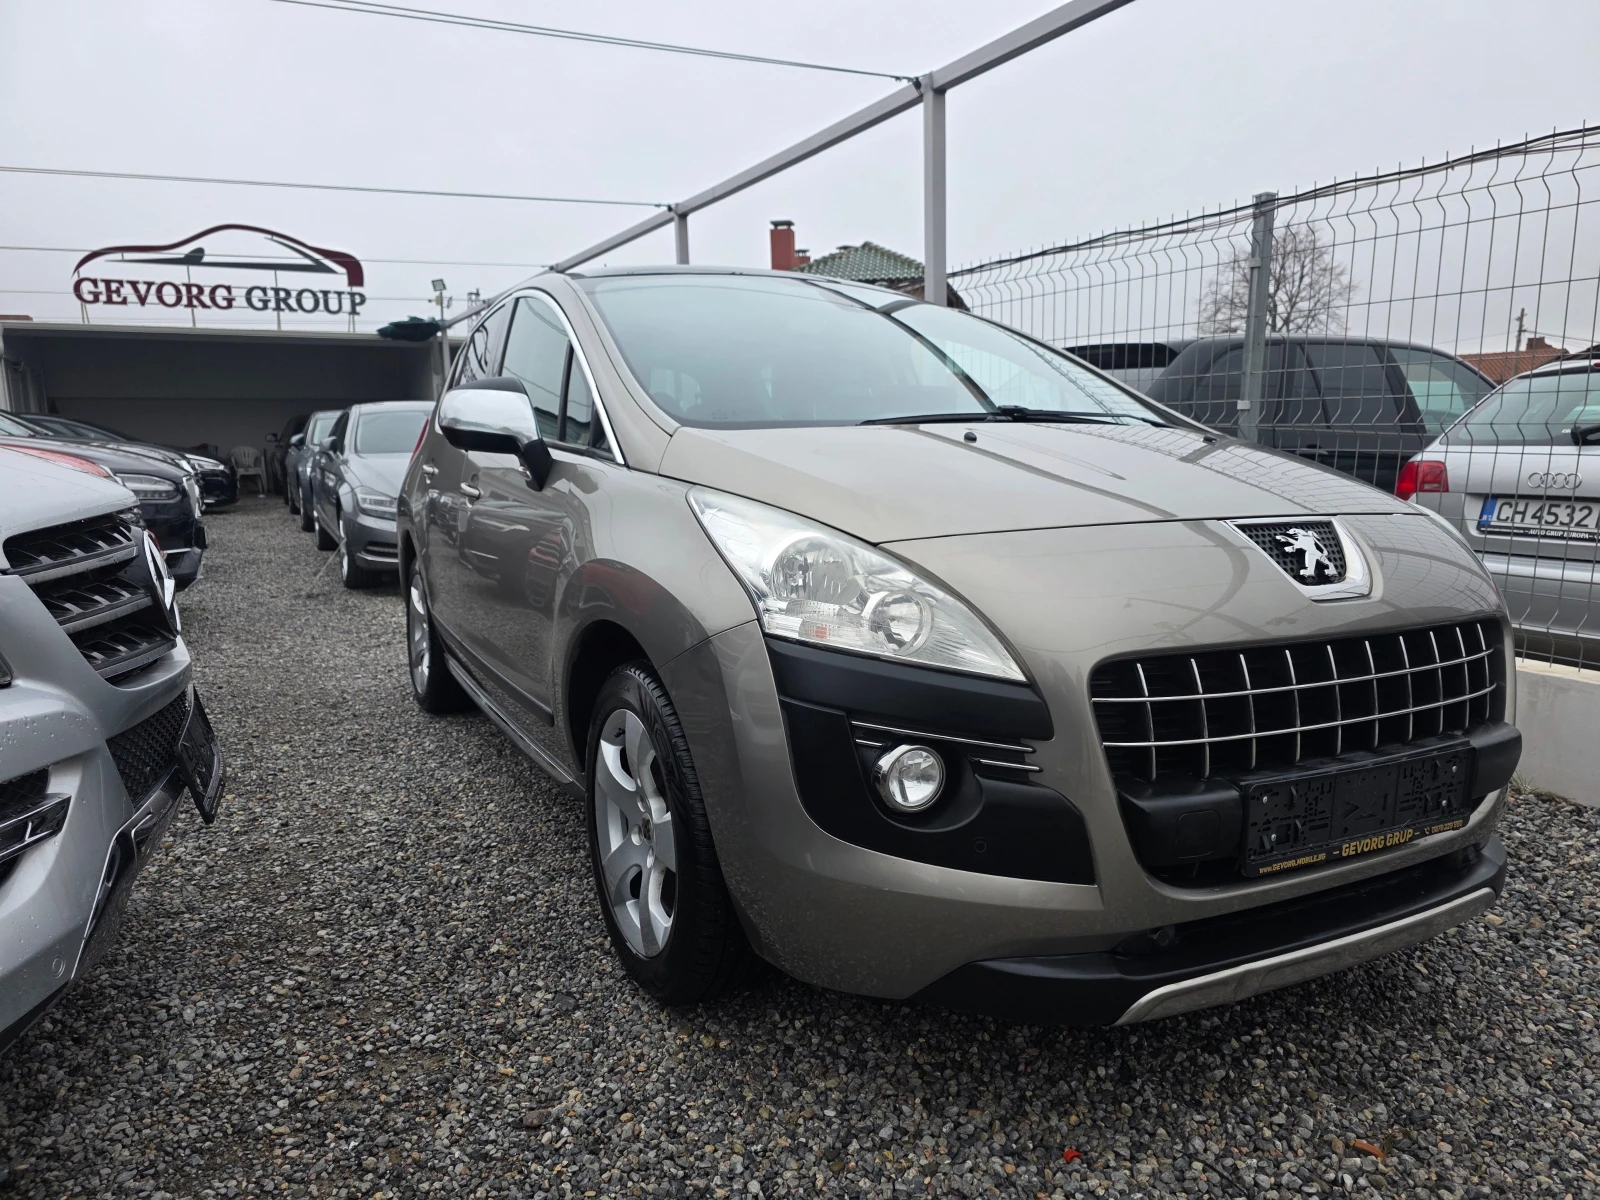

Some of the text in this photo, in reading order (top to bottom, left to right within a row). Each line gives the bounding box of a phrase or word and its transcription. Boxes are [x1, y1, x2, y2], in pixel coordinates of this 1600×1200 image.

[73, 276, 367, 316] GEVORG GROUP
[1341, 835, 1385, 857] GEVORG
[1385, 828, 1414, 851] GRUP
